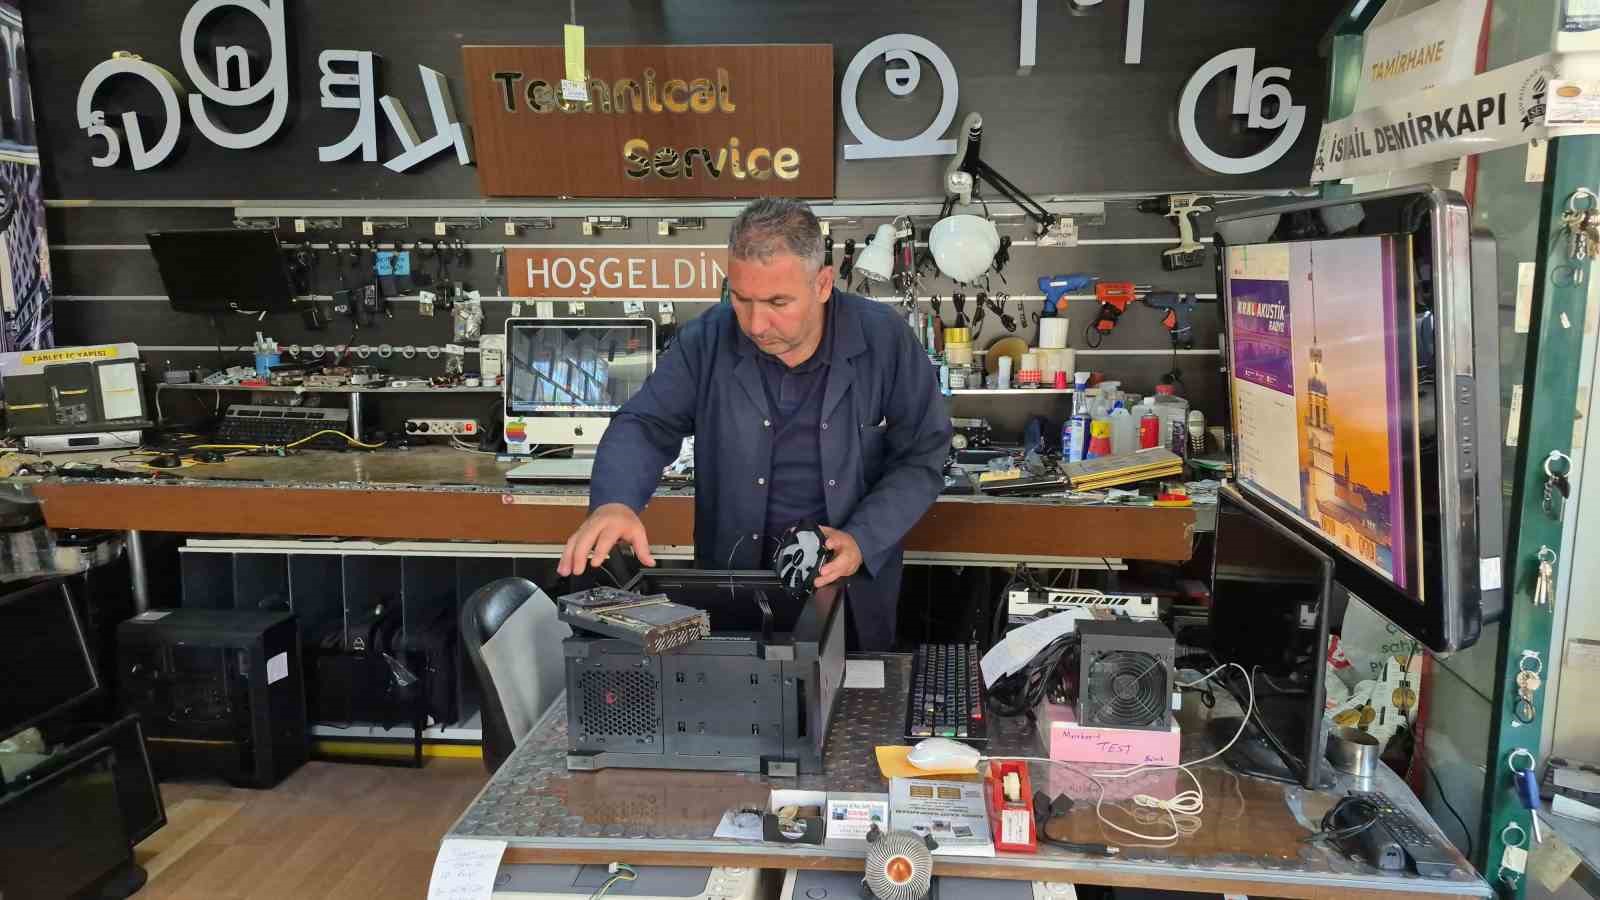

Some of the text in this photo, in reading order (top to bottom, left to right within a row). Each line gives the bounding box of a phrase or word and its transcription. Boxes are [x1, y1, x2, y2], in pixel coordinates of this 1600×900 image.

[1329, 127, 1372, 162] İSMAİL
[1374, 93, 1507, 154] DEMİRKAPI
[623, 136, 801, 180] Service
[1256, 300, 1286, 321] AKUSTİK
[1096, 741, 1134, 754] TEST
